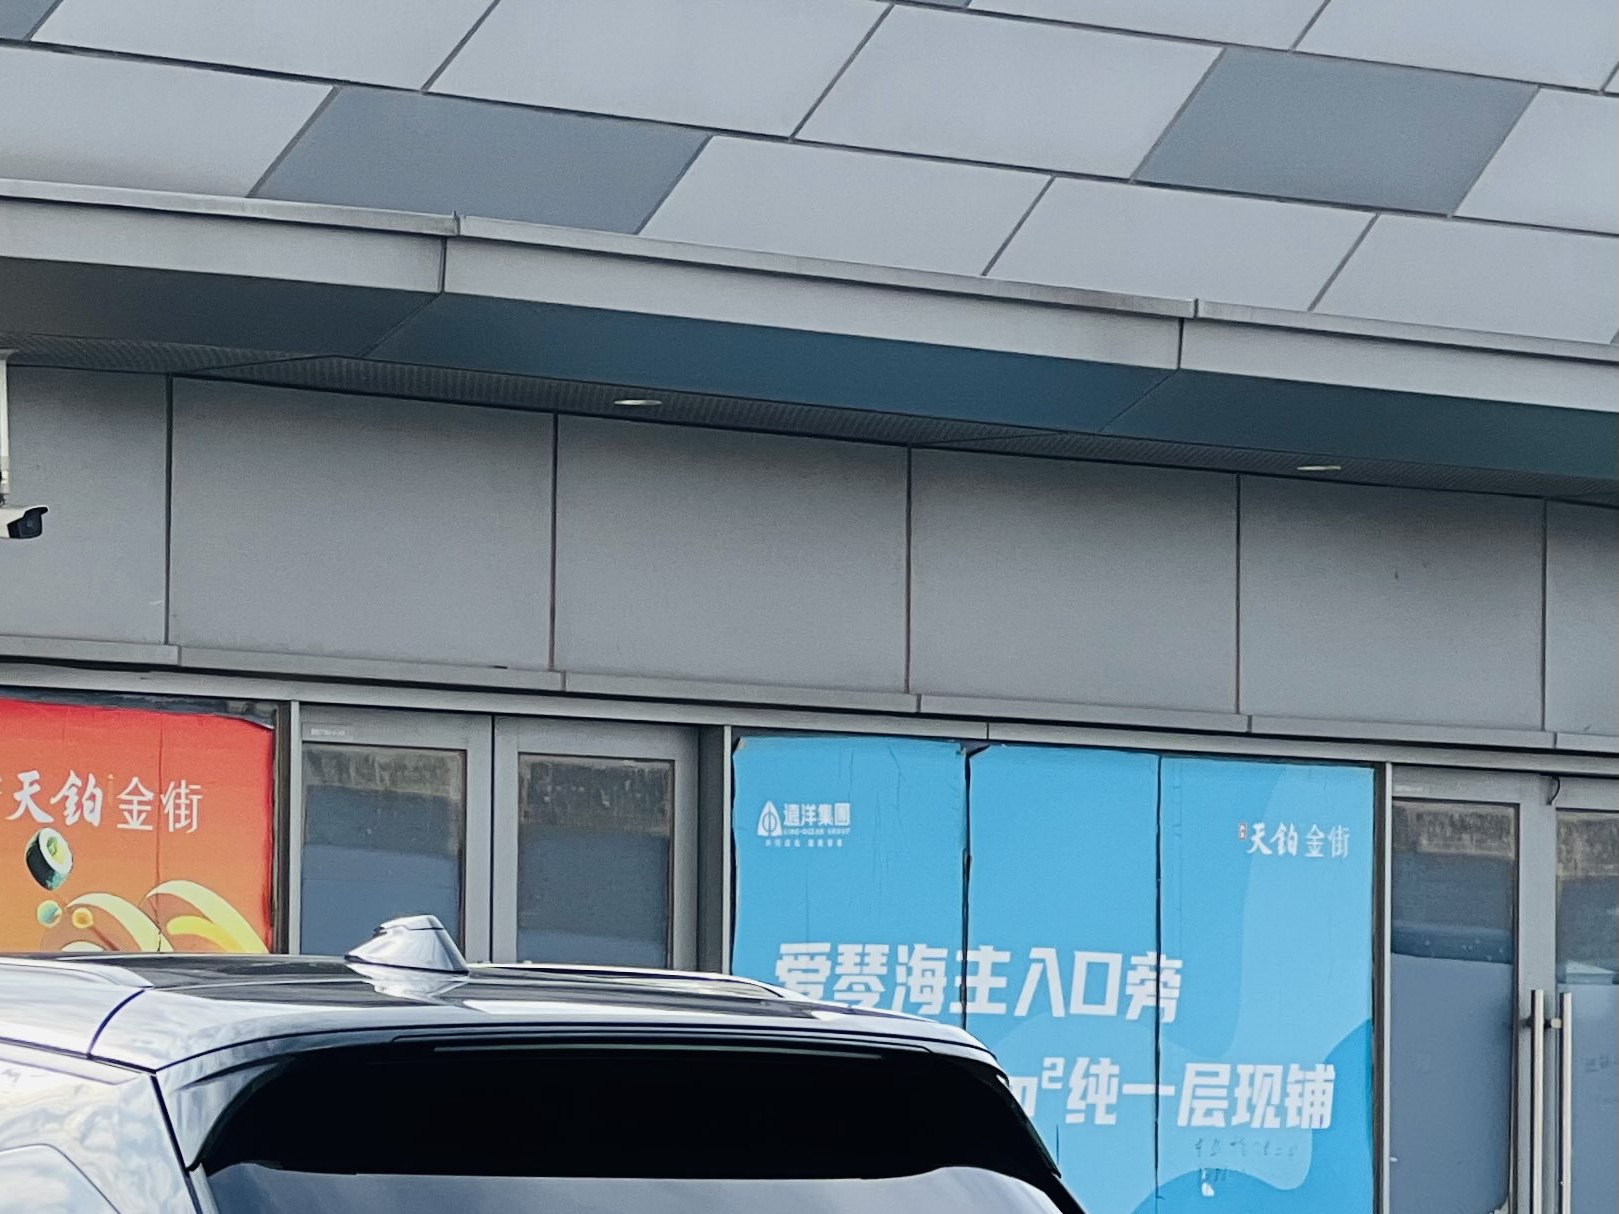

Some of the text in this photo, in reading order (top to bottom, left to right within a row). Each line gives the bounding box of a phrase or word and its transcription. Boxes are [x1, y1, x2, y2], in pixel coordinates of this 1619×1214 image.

[775, 941, 1183, 1024] 爱琴海主入口旁
